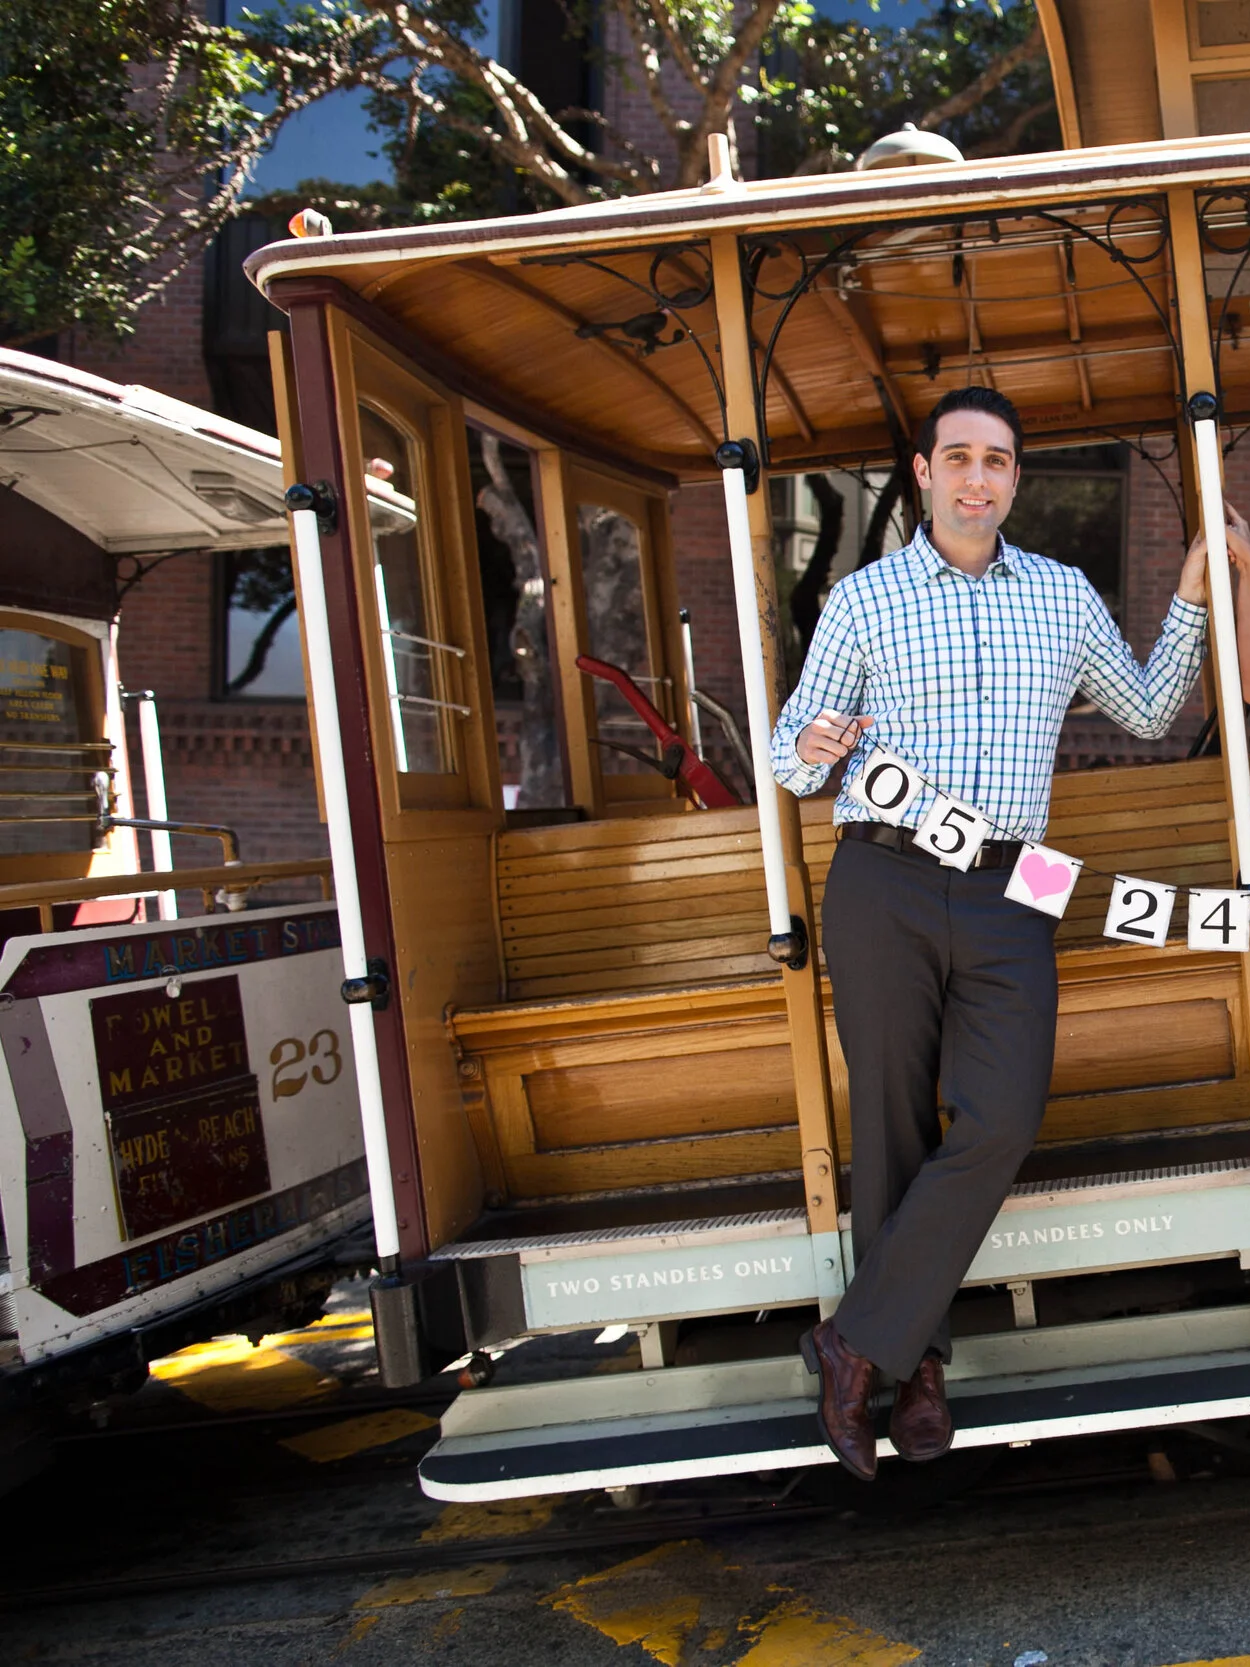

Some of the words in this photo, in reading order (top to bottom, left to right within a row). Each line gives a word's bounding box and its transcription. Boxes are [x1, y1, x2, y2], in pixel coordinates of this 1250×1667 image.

[105, 925, 268, 982] MARKET
[150, 1026, 213, 1057] AND
[269, 1029, 343, 1102] 23
[109, 1042, 246, 1097] MARKET
[119, 1129, 170, 1170] HYDE
[199, 1106, 256, 1143] BEACH
[990, 1221, 1104, 1249] STANDEES
[1114, 1214, 1174, 1236] ONLY
[547, 1277, 600, 1298] TWO
[610, 1263, 724, 1292] STANDEES
[734, 1256, 793, 1278] ONLY
